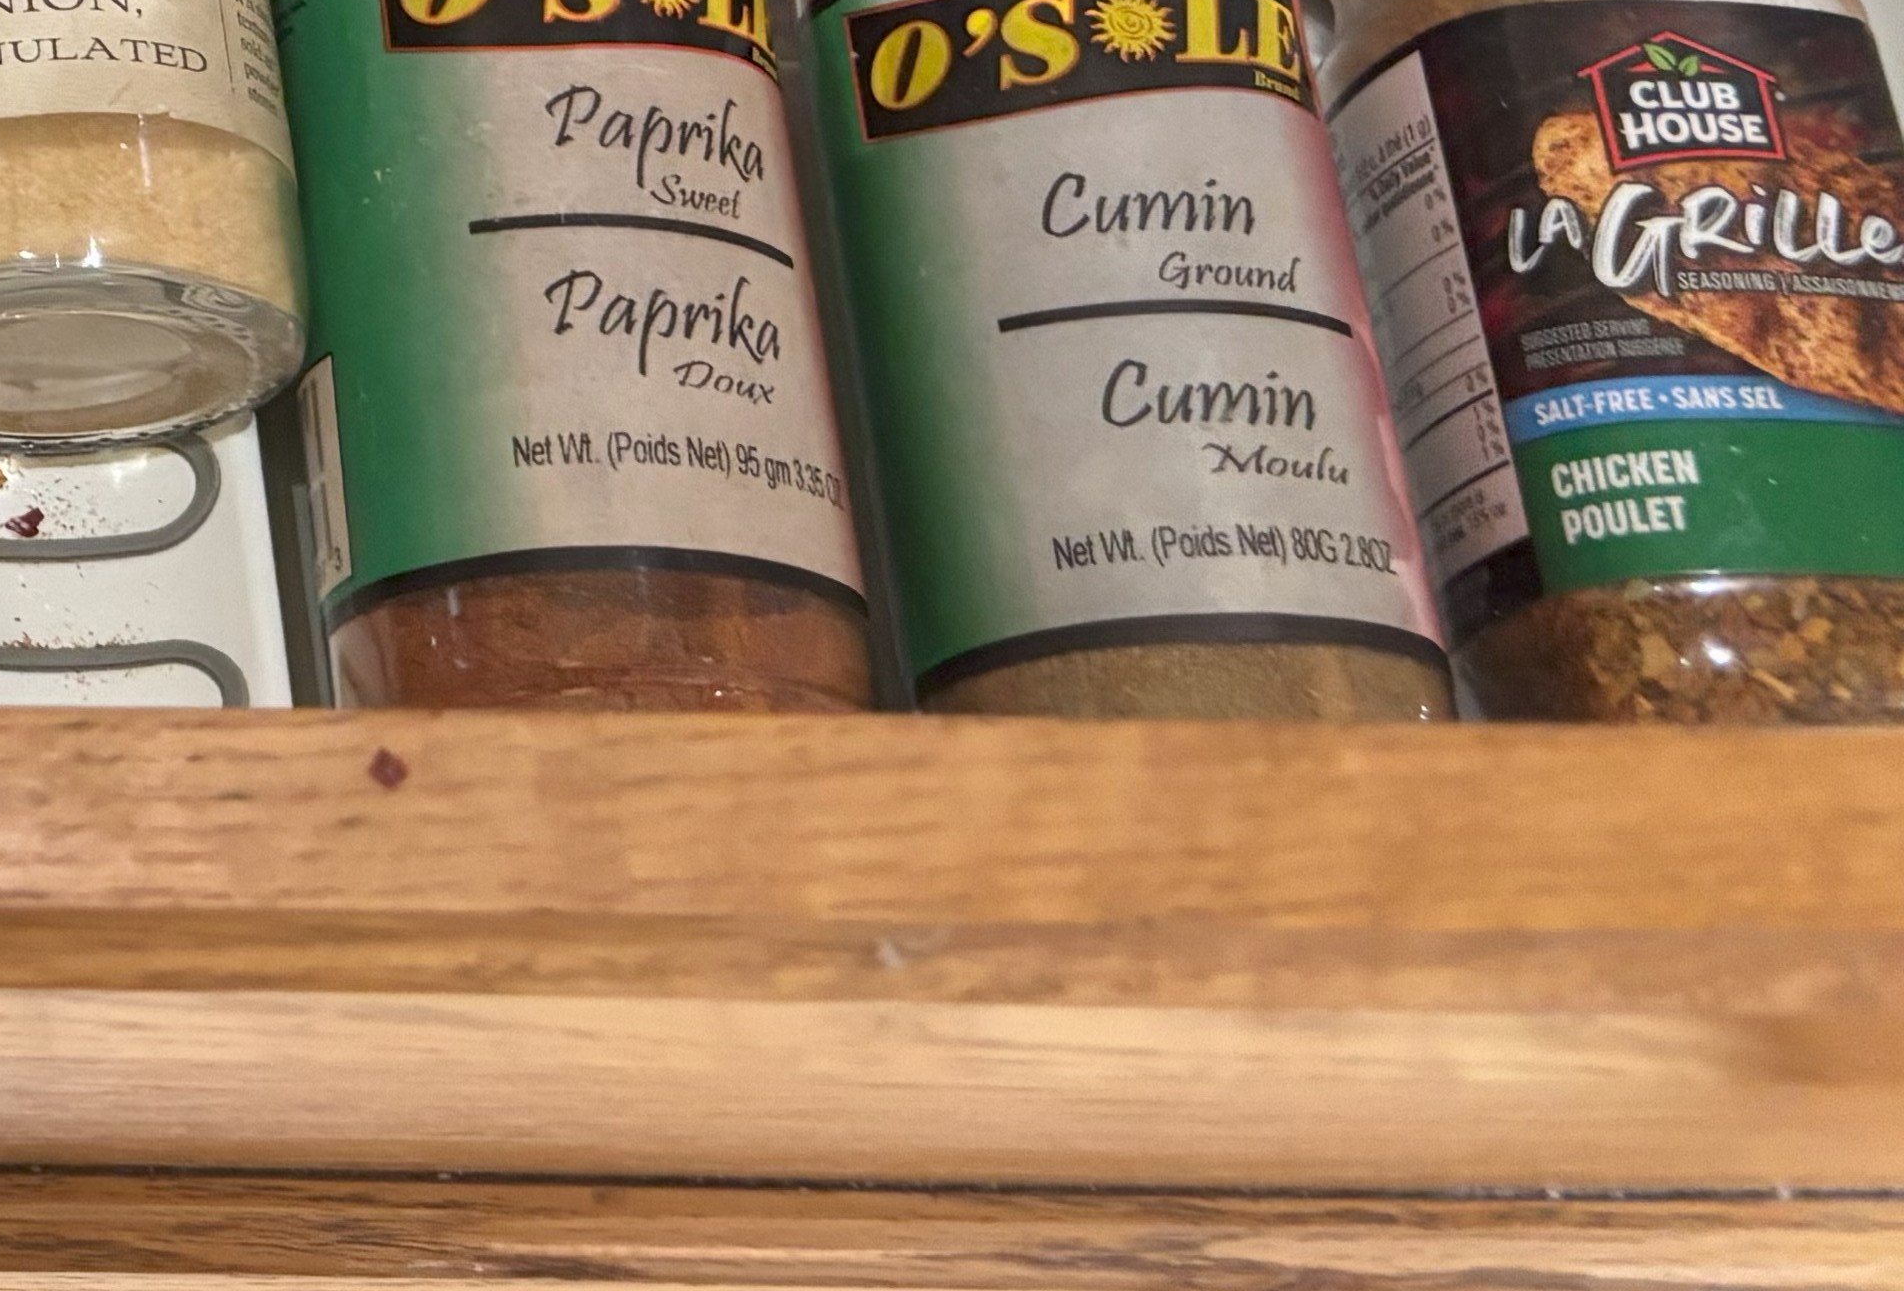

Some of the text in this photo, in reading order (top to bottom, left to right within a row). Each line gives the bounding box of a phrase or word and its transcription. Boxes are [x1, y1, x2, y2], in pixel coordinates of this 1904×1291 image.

[1629, 79, 1740, 111] CLUB
[545, 84, 767, 191] Paprika
[1620, 109, 1770, 151] HOUSE
[649, 174, 741, 220] Sweet
[1041, 172, 1255, 240] Cumin
[1158, 251, 1299, 295] Ground
[544, 269, 782, 376] Paprika
[672, 361, 774, 406] Doux
[1101, 359, 1316, 431] Cumin
[1534, 386, 1783, 428] SALT-FREE SANS SEL
[512, 431, 791, 489] Net Wt. (Poids Net) 95 gm
[1201, 441, 1351, 486] Moulu
[1551, 449, 1700, 501] CHICKEN
[1561, 495, 1687, 546] POULET
